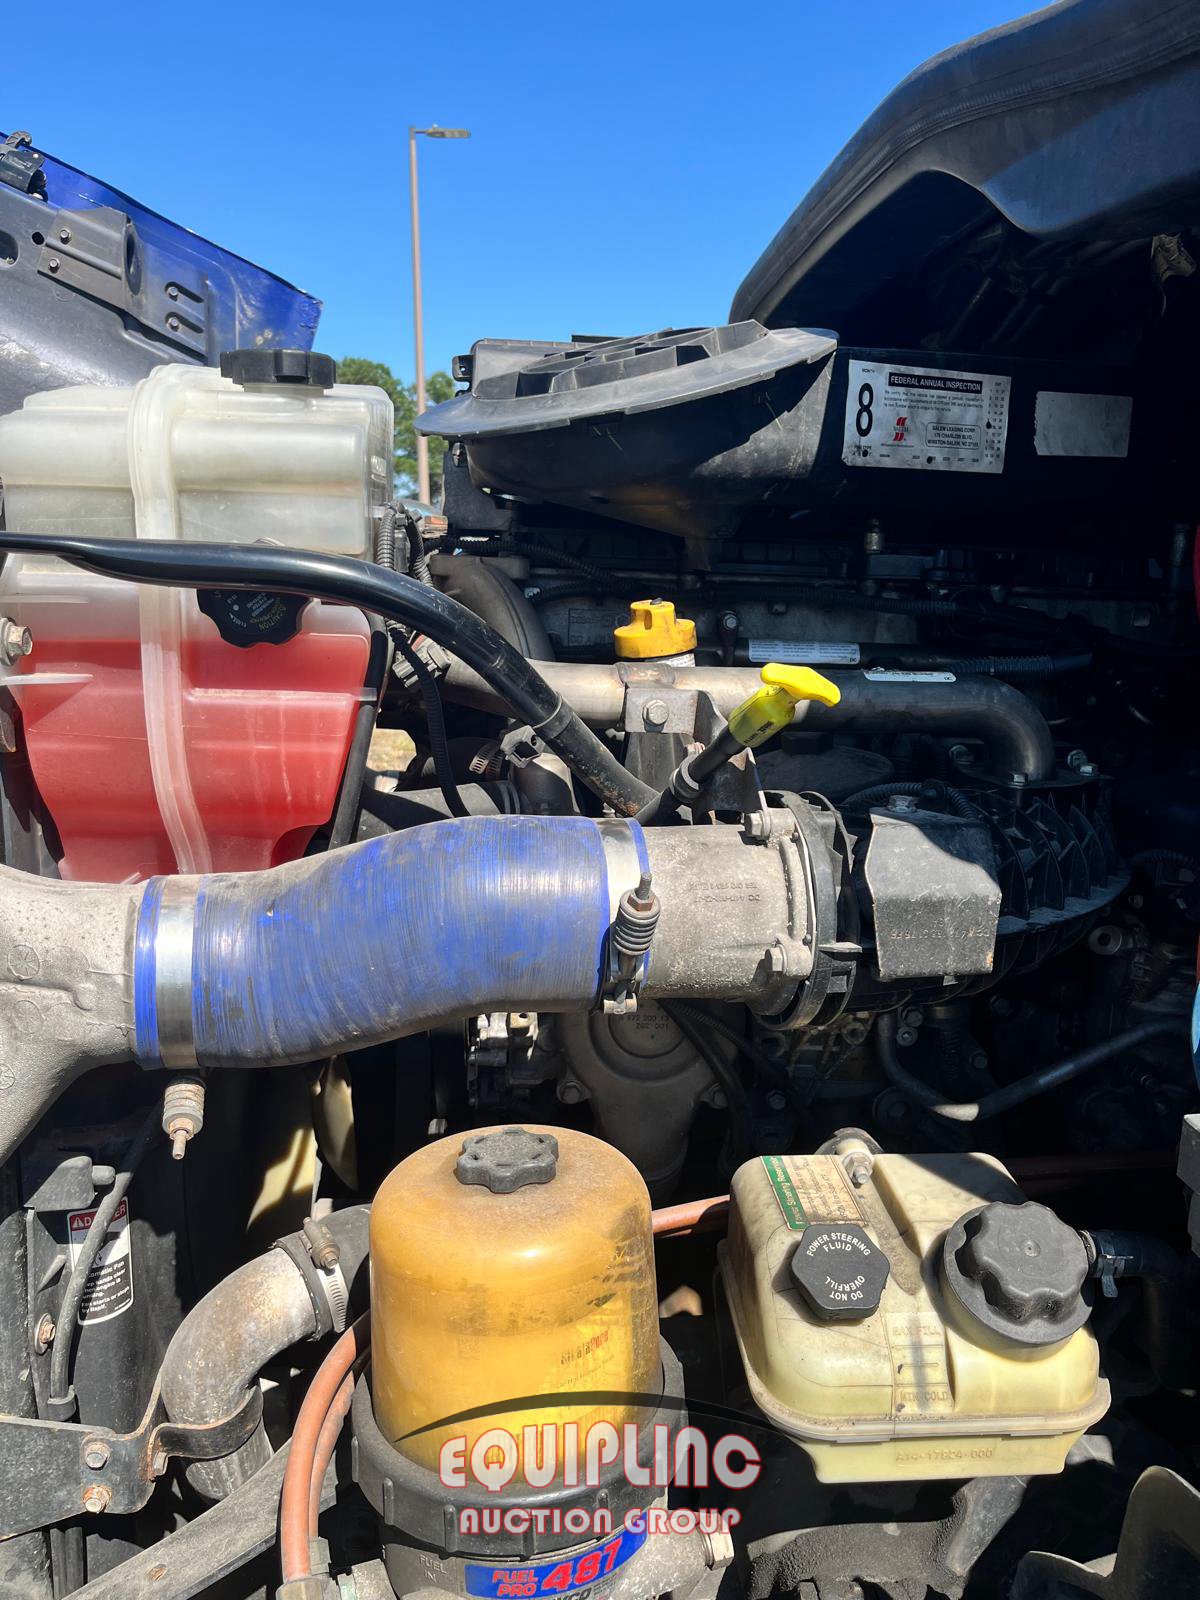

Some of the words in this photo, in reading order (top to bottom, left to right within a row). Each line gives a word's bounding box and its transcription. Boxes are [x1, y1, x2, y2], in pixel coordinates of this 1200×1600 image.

[890, 375, 920, 386] FEDERAL
[920, 378, 945, 388] ANNUAL
[945, 380, 981, 391] INSPECTION
[856, 383, 874, 437] 8
[84, 1204, 126, 1227] DER
[806, 1233, 830, 1257] POWER
[831, 1232, 871, 1256] STEERING
[823, 1241, 852, 1252] FLUID
[113, 1260, 125, 1271] Fan
[824, 1275, 866, 1292] OVERFILL
[829, 1291, 848, 1301] NOT
[850, 1290, 864, 1301] DO
[925, 1390, 949, 1401] COLD
[419, 1553, 449, 1575] FUEL
[540, 1536, 623, 1592] 487
[492, 1569, 539, 1583] FUEL
[496, 1583, 538, 1598] PRO
